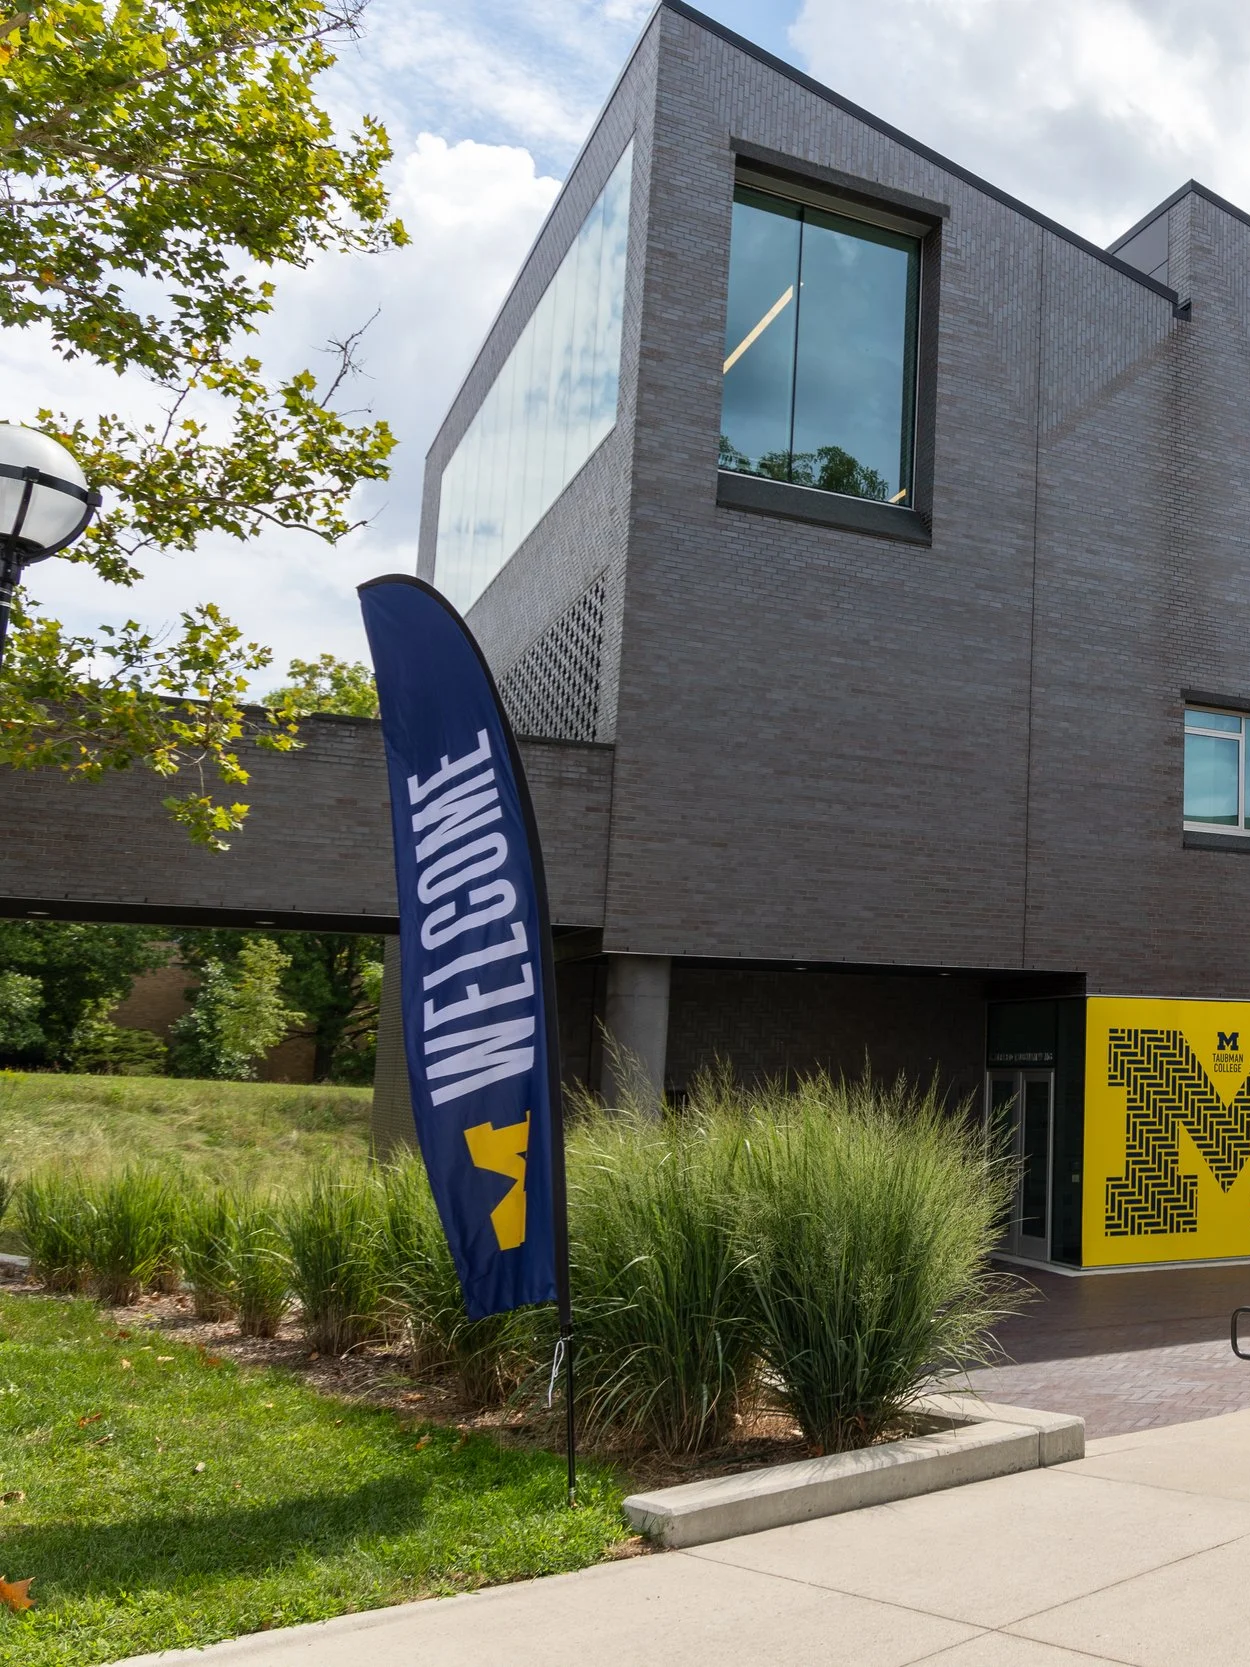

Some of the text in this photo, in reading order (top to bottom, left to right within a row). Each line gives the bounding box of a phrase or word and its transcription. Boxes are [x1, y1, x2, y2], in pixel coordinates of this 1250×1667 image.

[407, 728, 535, 1107] WELCOME
[1217, 1031, 1239, 1050] M
[1212, 1053, 1244, 1063] TAUBMAN
[1213, 1063, 1242, 1073] COLLEGE
